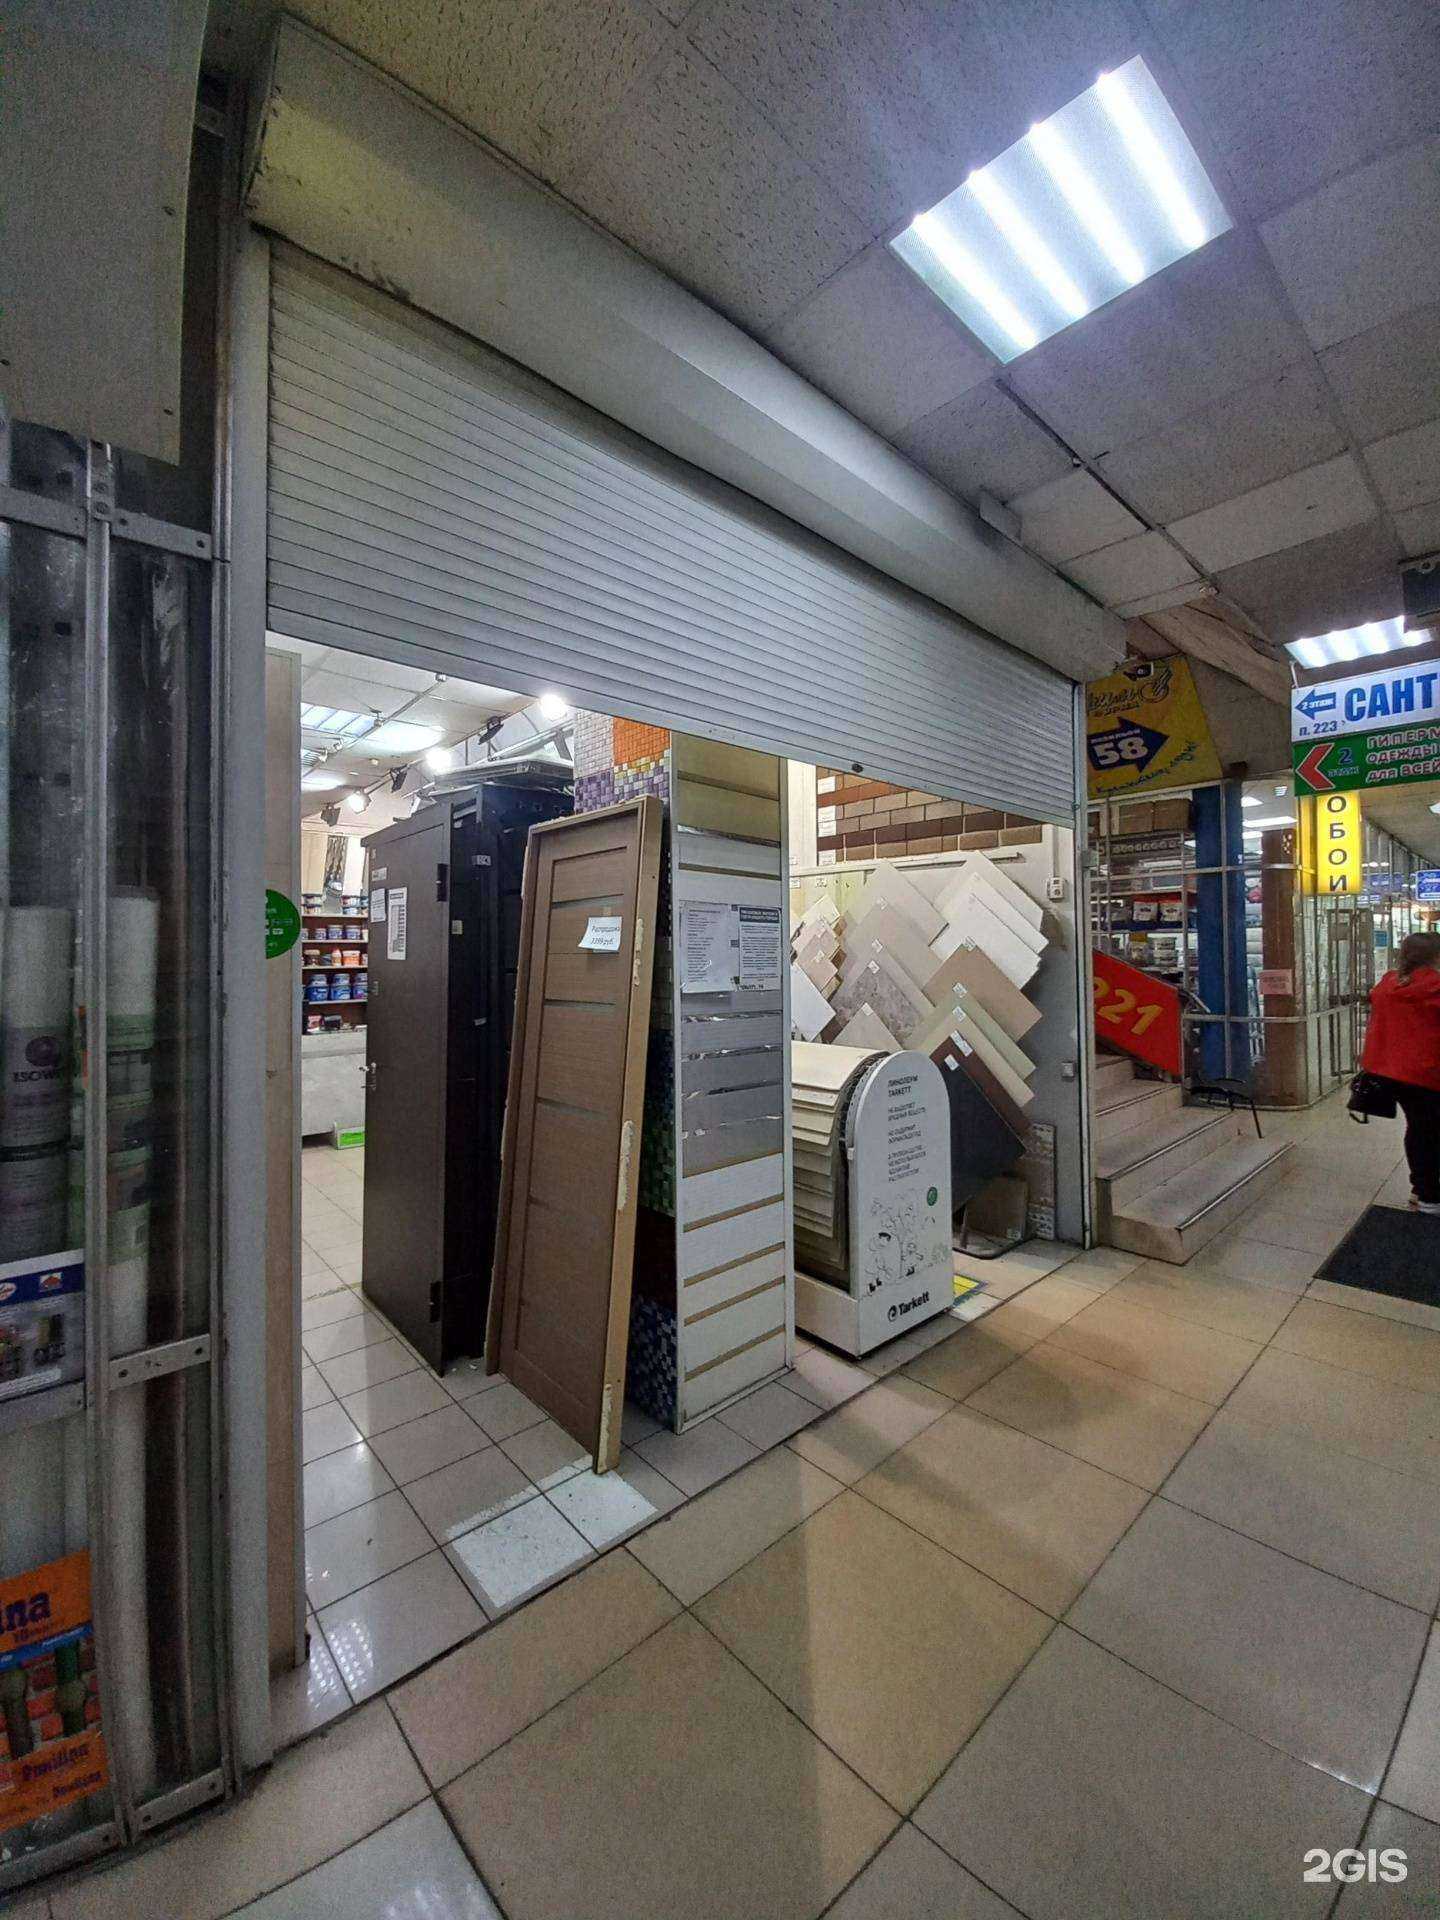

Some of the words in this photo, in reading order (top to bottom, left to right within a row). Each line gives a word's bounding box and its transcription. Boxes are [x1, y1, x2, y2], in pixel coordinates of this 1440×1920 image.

[1345, 672, 1438, 721] САНТ
[1313, 720, 1338, 735] 223
[1092, 736, 1149, 766] 58
[1339, 747, 1353, 765] 2
[1327, 796, 1347, 891] ОБОИ
[899, 1291, 930, 1315] Tarkett
